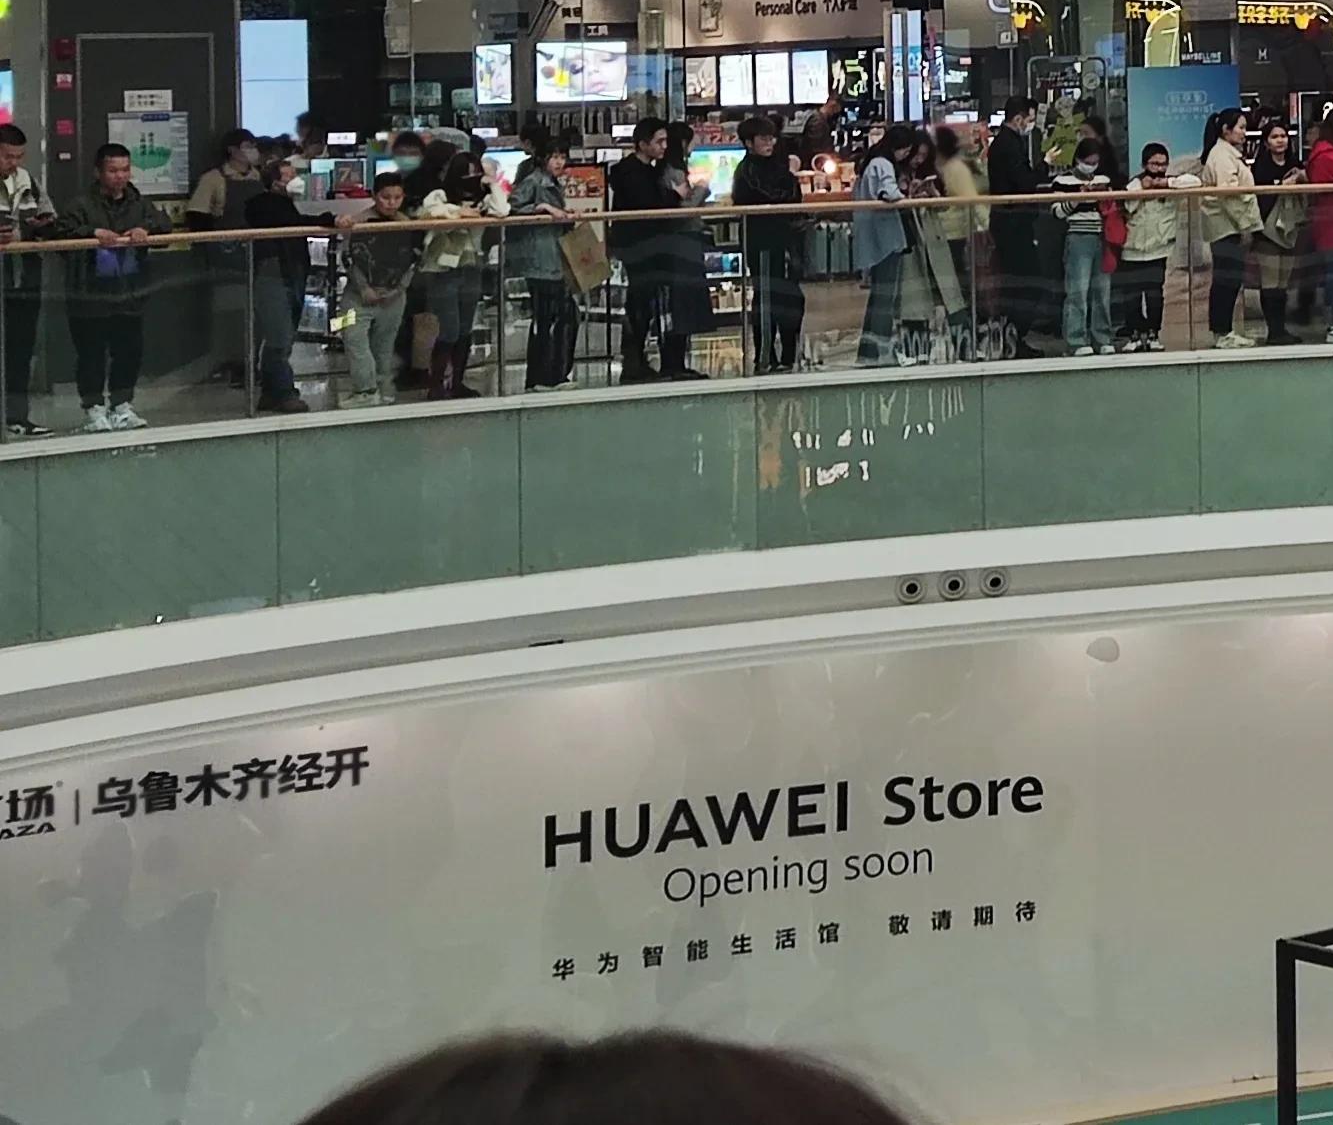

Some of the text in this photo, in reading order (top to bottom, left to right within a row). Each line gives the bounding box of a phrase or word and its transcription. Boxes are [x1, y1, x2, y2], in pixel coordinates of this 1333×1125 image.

[755, 0, 794, 17] Personal
[0, 745, 370, 824] 场 乌鲁木齐经开
[543, 774, 1045, 869] HUAWEI Store
[663, 847, 934, 908] Opening soon
[552, 900, 1037, 982] 华为智能生活馆 敬请期待
